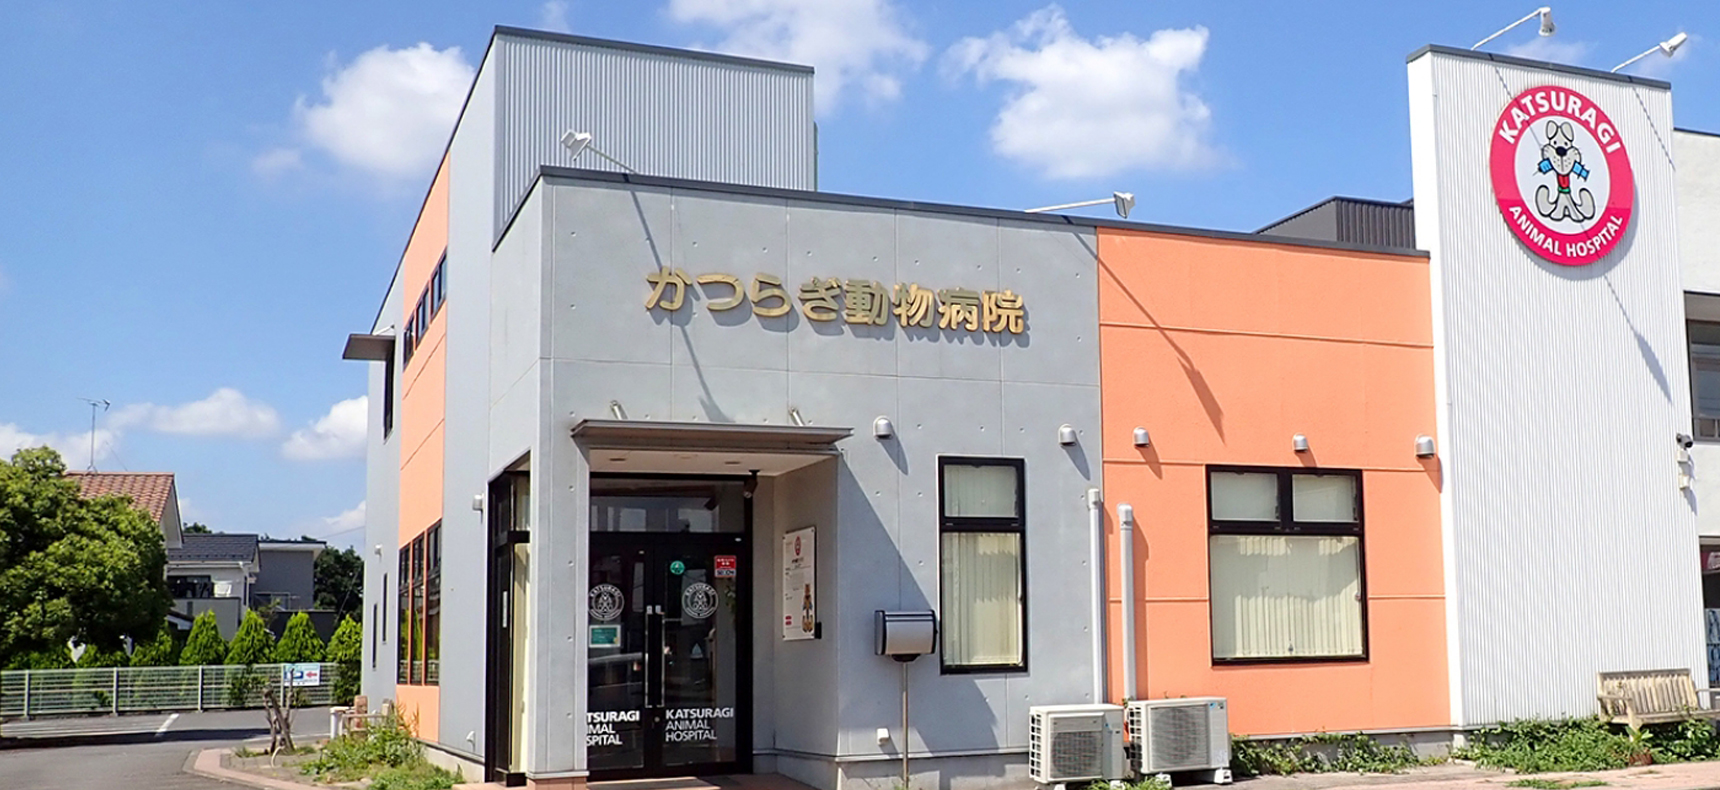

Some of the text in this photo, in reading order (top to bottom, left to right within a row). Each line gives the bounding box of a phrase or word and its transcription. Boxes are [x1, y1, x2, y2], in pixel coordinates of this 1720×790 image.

[1499, 90, 1621, 153] KATSURAGI
[1509, 206, 1624, 258] ANIMAL HOSPITAL
[645, 265, 1025, 334] かつらぎ動物病院
[665, 707, 734, 720] KATSURAGI
[665, 719, 711, 731] ANIMAL
[665, 730, 718, 742] HOSPITAL
